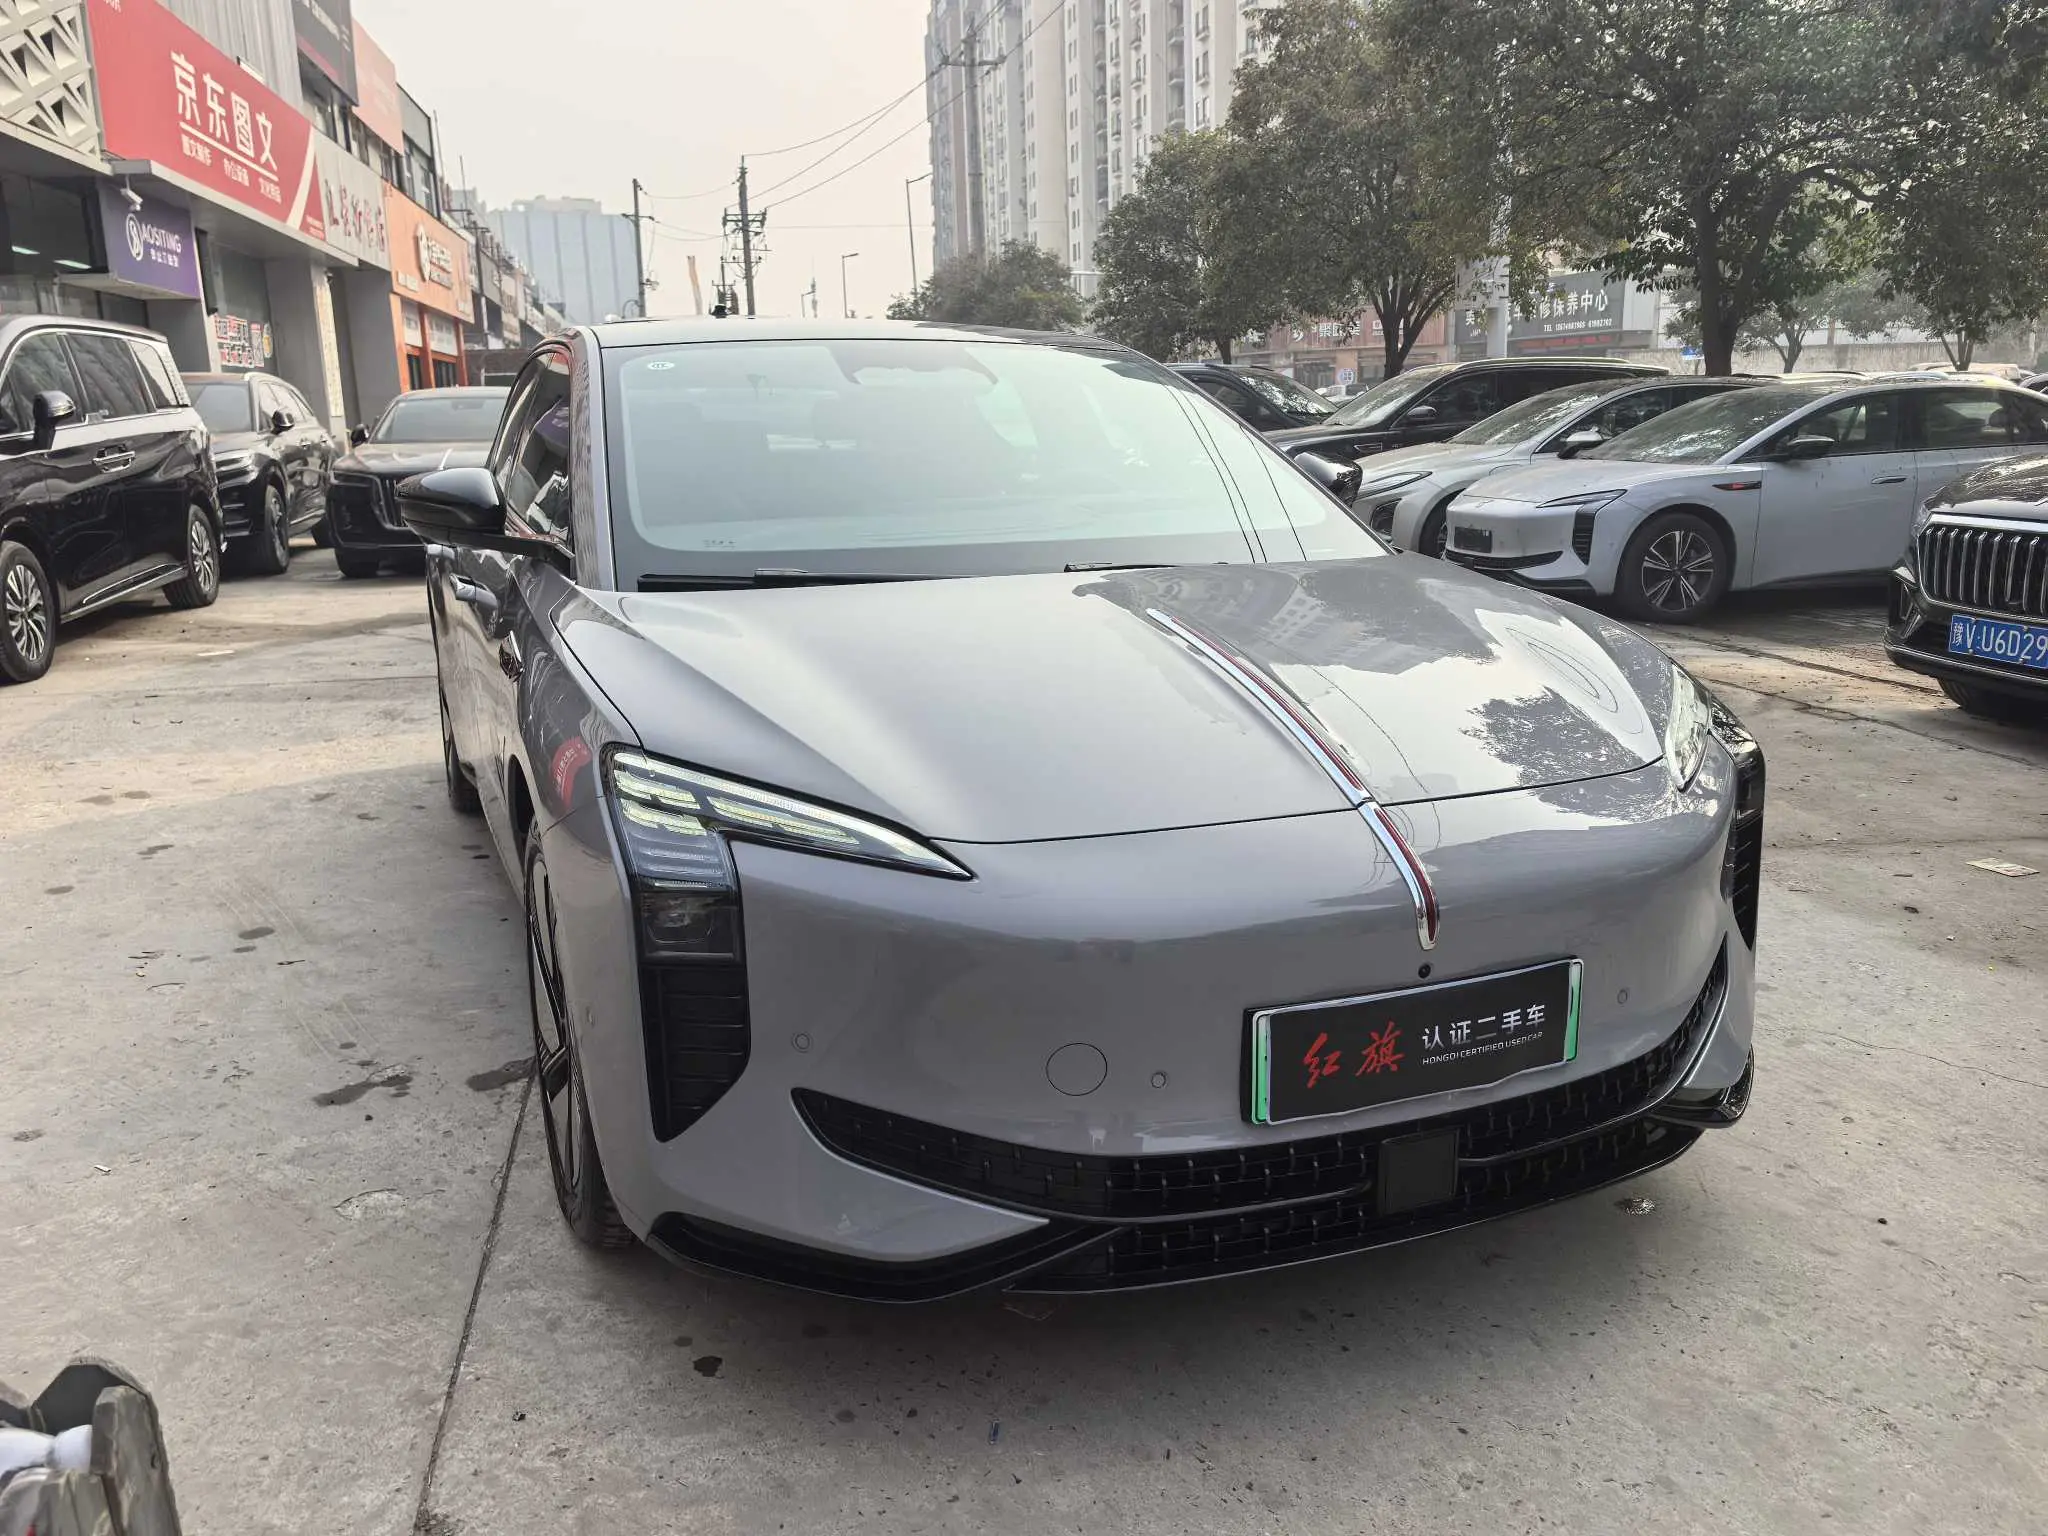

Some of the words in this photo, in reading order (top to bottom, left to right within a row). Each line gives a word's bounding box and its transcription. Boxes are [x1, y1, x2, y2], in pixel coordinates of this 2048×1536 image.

[170, 50, 278, 171] 京东图文
[1422, 1004, 1545, 1050] 认证二手车
[1460, 1042, 1504, 1058] CERTIFIED
